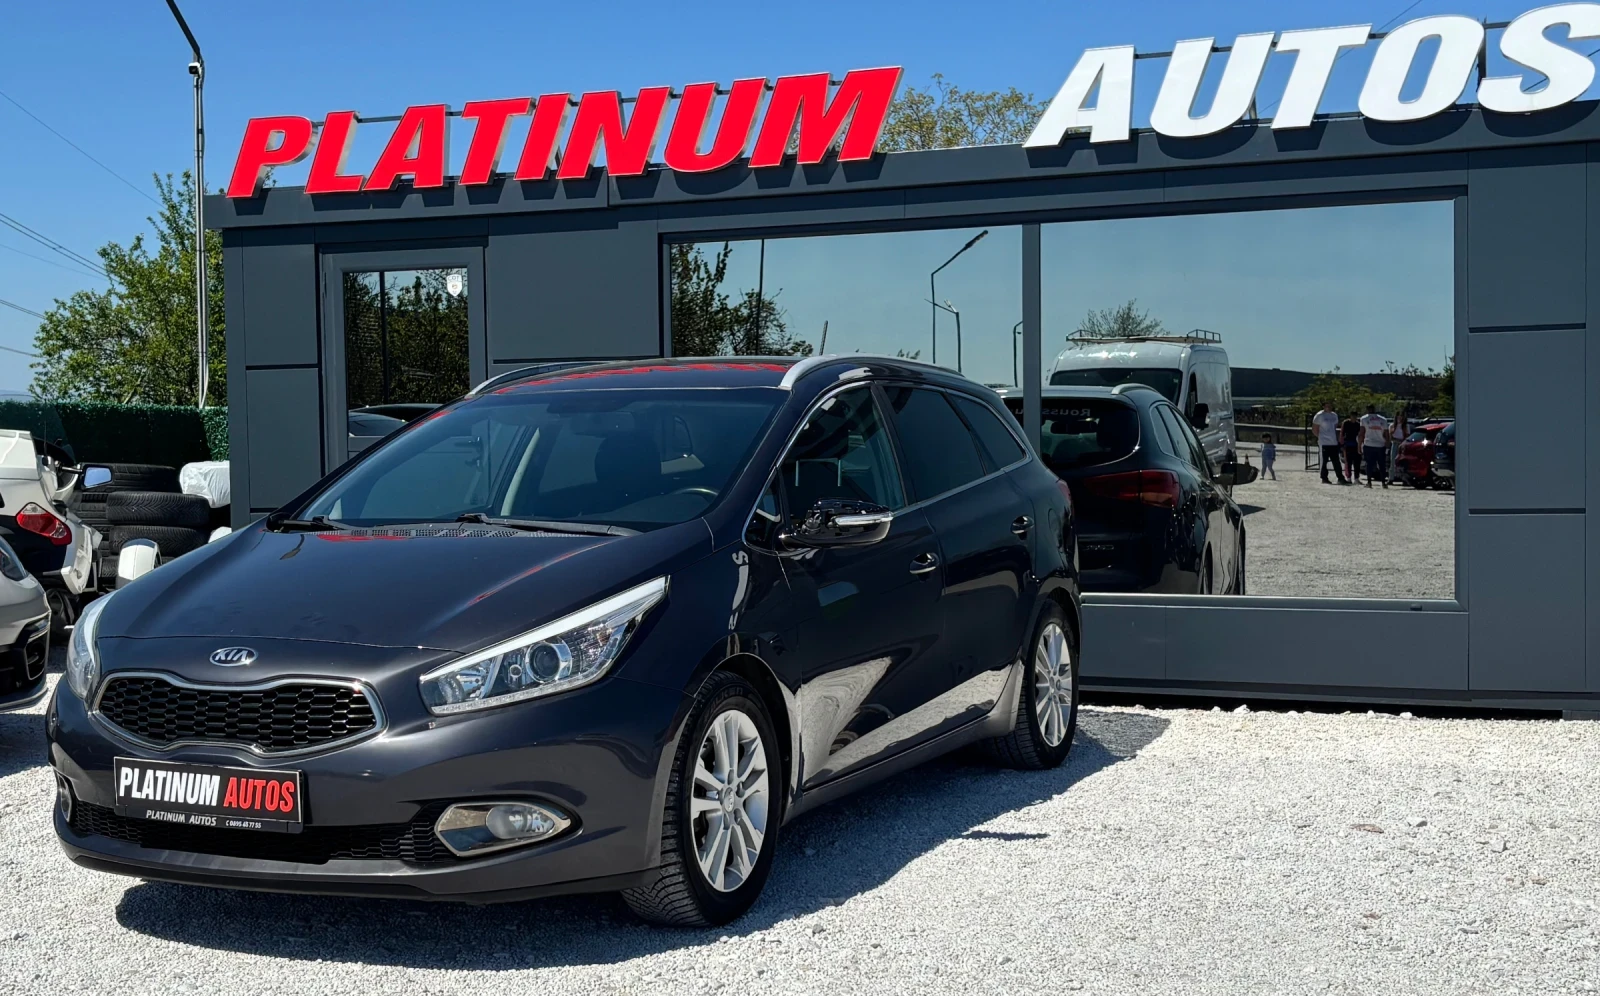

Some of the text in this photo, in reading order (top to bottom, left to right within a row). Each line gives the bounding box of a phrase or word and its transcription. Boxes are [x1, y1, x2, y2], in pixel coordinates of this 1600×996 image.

[225, 2, 1600, 198] PLATINUM AUTOS
[214, 649, 249, 662] KIA
[119, 766, 295, 813] PLATINUM AUTOS
[145, 810, 185, 823] PLATINUM
[189, 814, 217, 826] AUTOS
